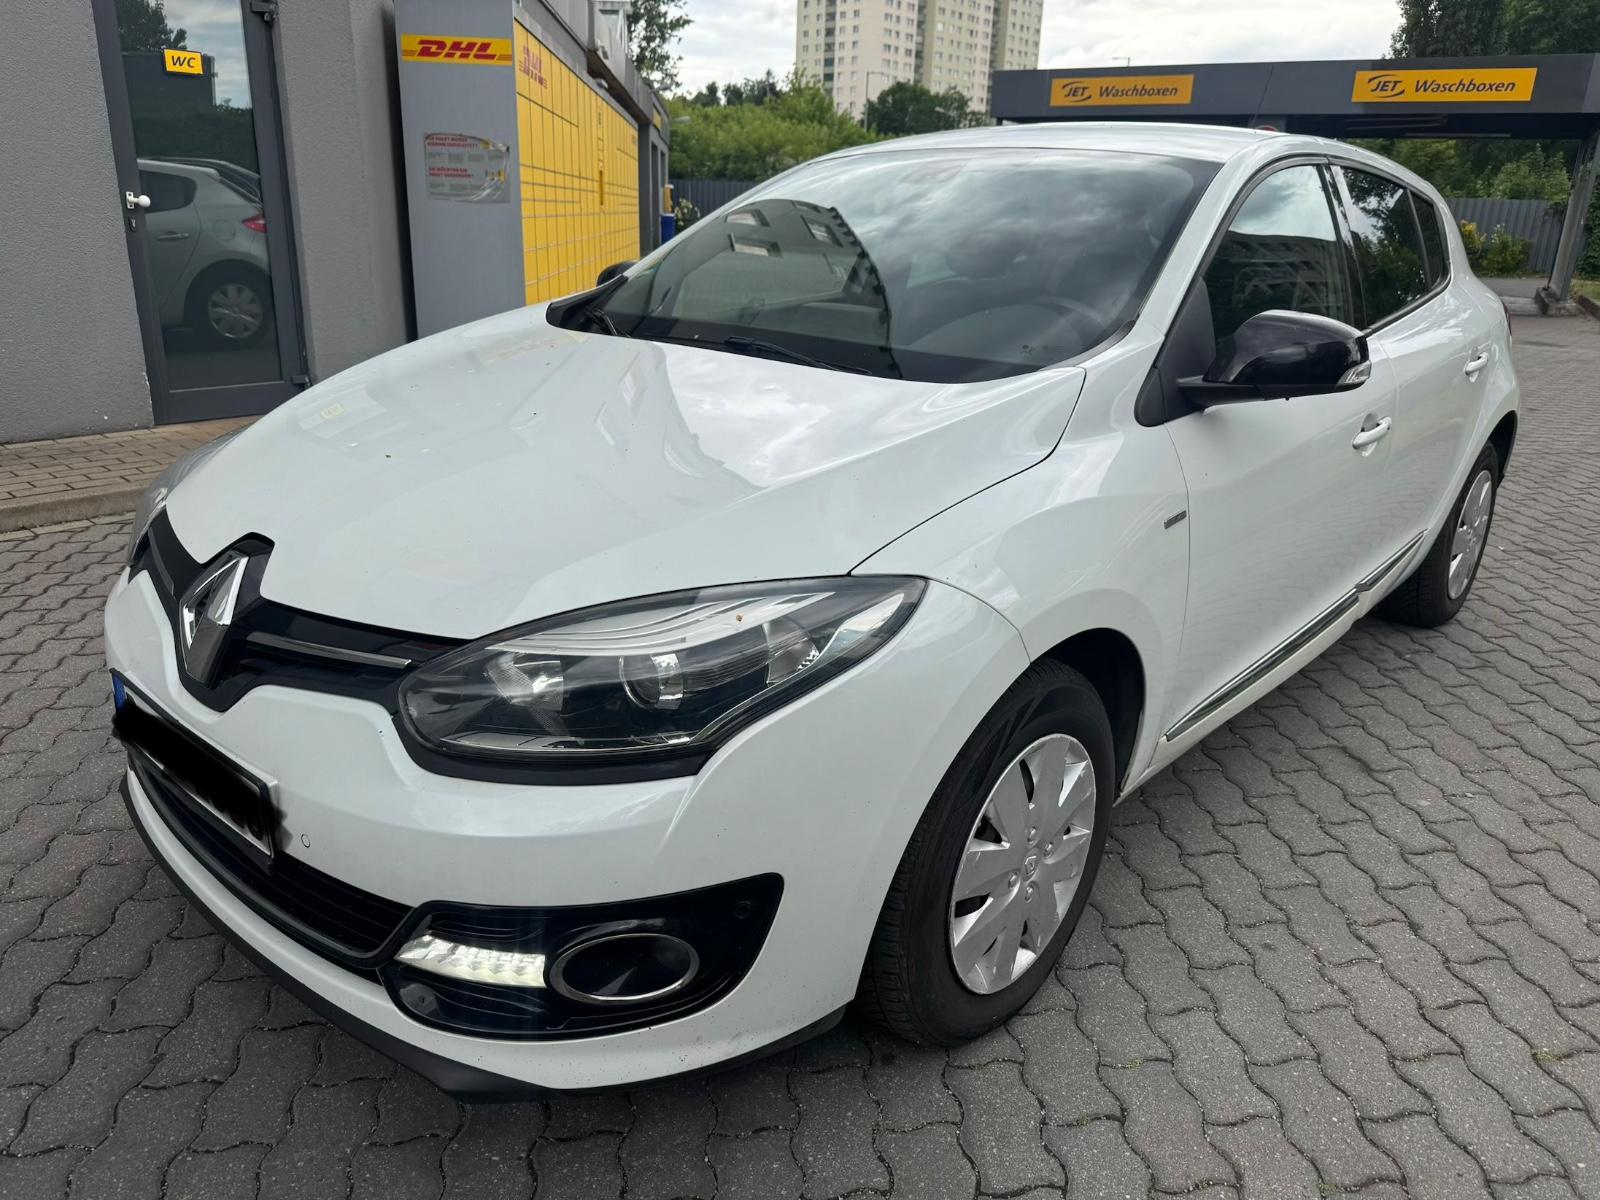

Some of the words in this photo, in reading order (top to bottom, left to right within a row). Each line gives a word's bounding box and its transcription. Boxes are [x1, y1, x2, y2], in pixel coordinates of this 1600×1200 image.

[416, 39, 497, 60] DHL
[171, 55, 196, 68] WC
[1063, 86, 1090, 98] JET
[1099, 84, 1178, 97] Waschboxen
[1370, 79, 1403, 93] JET
[1414, 78, 1516, 93] Waschboxen
